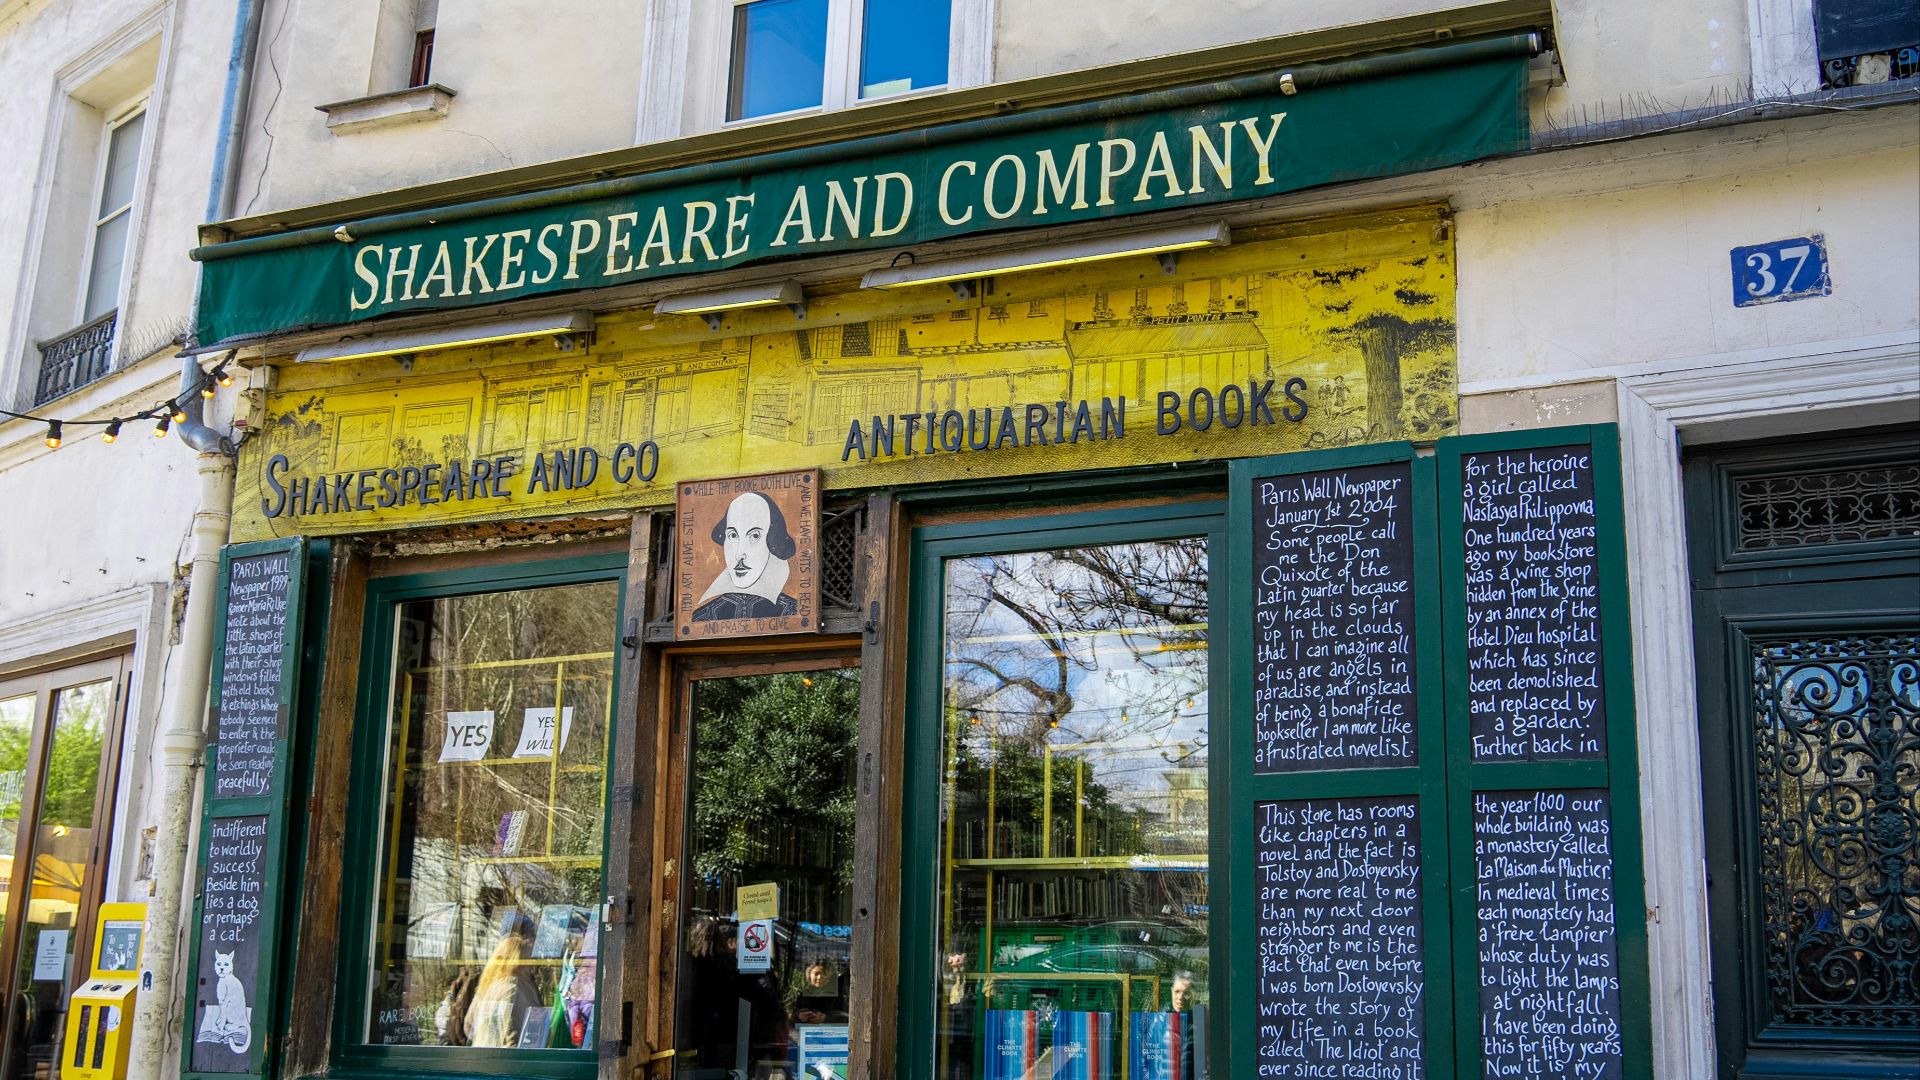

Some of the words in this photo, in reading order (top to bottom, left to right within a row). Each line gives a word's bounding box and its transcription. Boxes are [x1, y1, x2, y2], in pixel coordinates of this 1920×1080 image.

[350, 193, 755, 311] SHAKESPEARE
[769, 172, 914, 247] AND
[938, 111, 1287, 227] COMPANY
[1746, 246, 1810, 296] 37
[617, 367, 668, 380] SHAKESPEARE
[688, 362, 704, 370] AND
[841, 395, 1126, 462] ANTIQUARIAN
[1156, 377, 1309, 436] BOOKS
[1466, 457, 1490, 480] for
[1498, 456, 1525, 475] the
[1530, 453, 1588, 473] heroine
[261, 454, 514, 519] SHAKESPEARE
[527, 447, 598, 494] AND
[612, 440, 660, 484] CO
[692, 482, 713, 496] WHILE
[718, 483, 730, 494] THY
[735, 479, 757, 493] BOOKE
[761, 477, 781, 490] DOTH
[784, 474, 801, 488] LIVE
[1261, 482, 1299, 504] Paris
[1302, 477, 1330, 501] Wall
[1335, 473, 1401, 502] Newspaper
[1464, 483, 1473, 497] a
[1479, 476, 1515, 503] girl
[1519, 471, 1577, 493] called
[800, 486, 811, 503] AND
[684, 508, 694, 535] STILL
[800, 505, 811, 517] WE
[1267, 506, 1321, 532] January
[1325, 501, 1340, 521] 1st
[1348, 495, 1397, 518] 2004
[1463, 498, 1517, 526] Nastasya
[800, 520, 811, 543] HAVE
[1266, 531, 1309, 549] Some
[1317, 526, 1365, 552] people
[1372, 521, 1395, 539] call
[1465, 529, 1493, 547] One
[1497, 523, 1555, 543] hundred
[1559, 526, 1595, 548] years
[682, 539, 694, 566] ALIVE
[800, 551, 811, 573] WITS
[1279, 553, 1298, 565] me
[1310, 548, 1337, 563] the
[1344, 543, 1379, 561] Don
[233, 562, 261, 579] PARIS
[264, 558, 289, 575] WALL
[682, 572, 692, 589] ART
[1262, 565, 1331, 587] Quixote
[1338, 562, 1352, 582] of
[1360, 562, 1390, 576] the
[230, 580, 270, 597] Newspaper
[271, 575, 288, 592] 1999
[800, 578, 811, 589] TO
[1258, 587, 1296, 606] Latin
[1301, 581, 1344, 605] quarter
[1352, 578, 1408, 596] because
[229, 602, 248, 615] Rainer
[249, 600, 266, 613] Maria
[267, 597, 287, 612] Rilke
[682, 590, 692, 612] THOU
[800, 592, 811, 616] READ
[228, 615, 248, 627] wrote
[250, 613, 271, 626] about
[273, 613, 285, 625] the
[703, 622, 718, 635] AND
[721, 619, 750, 632] PRAISE
[757, 621, 765, 630] TO
[769, 618, 790, 630] GIVE
[1264, 630, 1281, 647] up
[1292, 625, 1304, 640] in
[1312, 621, 1337, 638] the
[1346, 618, 1402, 635] clouds
[1470, 674, 1502, 692] been
[1508, 667, 1598, 689] demolished
[1471, 695, 1495, 713] and
[1501, 690, 1571, 716] replaced
[1578, 692, 1597, 718] by
[538, 717, 555, 728] YES
[542, 729, 546, 739] I
[1495, 717, 1504, 731] a
[1513, 712, 1589, 736] garden.
[450, 724, 488, 748] YES
[1473, 735, 1527, 757] Further
[1533, 734, 1572, 753] back
[1580, 733, 1598, 752] in
[1256, 748, 1263, 762] a
[1267, 738, 1344, 767] frustrated
[1349, 736, 1413, 758] novelist.
[1260, 804, 1295, 826] This
[1301, 803, 1333, 824] store
[1338, 802, 1362, 821] has
[1370, 804, 1414, 820] rooms
[1475, 794, 1498, 813] the
[1501, 800, 1530, 819] year
[1534, 792, 1564, 812] 1600
[1572, 799, 1602, 812] our
[213, 818, 267, 840] indifferent
[1259, 826, 1293, 843] like
[1298, 824, 1367, 847] chapters
[1375, 822, 1386, 837] in
[1396, 824, 1405, 837] a
[1475, 815, 1512, 834] whole
[1515, 815, 1575, 842] building
[1578, 820, 1609, 834] was
[210, 842, 219, 858] to
[222, 840, 262, 860] worldly
[206, 876, 238, 892] Beside
[241, 875, 259, 892] him
[1261, 887, 1288, 900] are
[1296, 887, 1332, 900] more
[1338, 881, 1368, 898] real
[1376, 882, 1389, 898] to
[1395, 888, 1417, 900] me
[1478, 884, 1491, 901] In
[1497, 881, 1556, 900] medieval
[1565, 880, 1609, 901] times
[206, 894, 224, 909] lies
[228, 896, 233, 908] a
[238, 894, 259, 918] dog
[1262, 903, 1295, 920] than
[1304, 907, 1324, 923] my
[1331, 902, 1363, 917] next
[1371, 902, 1413, 917] door
[1478, 902, 1507, 920] each
[1513, 901, 1582, 929] monastery
[1588, 902, 1614, 924] had
[204, 913, 214, 924] or
[217, 910, 252, 928] perhaps
[210, 929, 215, 940] a
[221, 926, 244, 941] cat.
